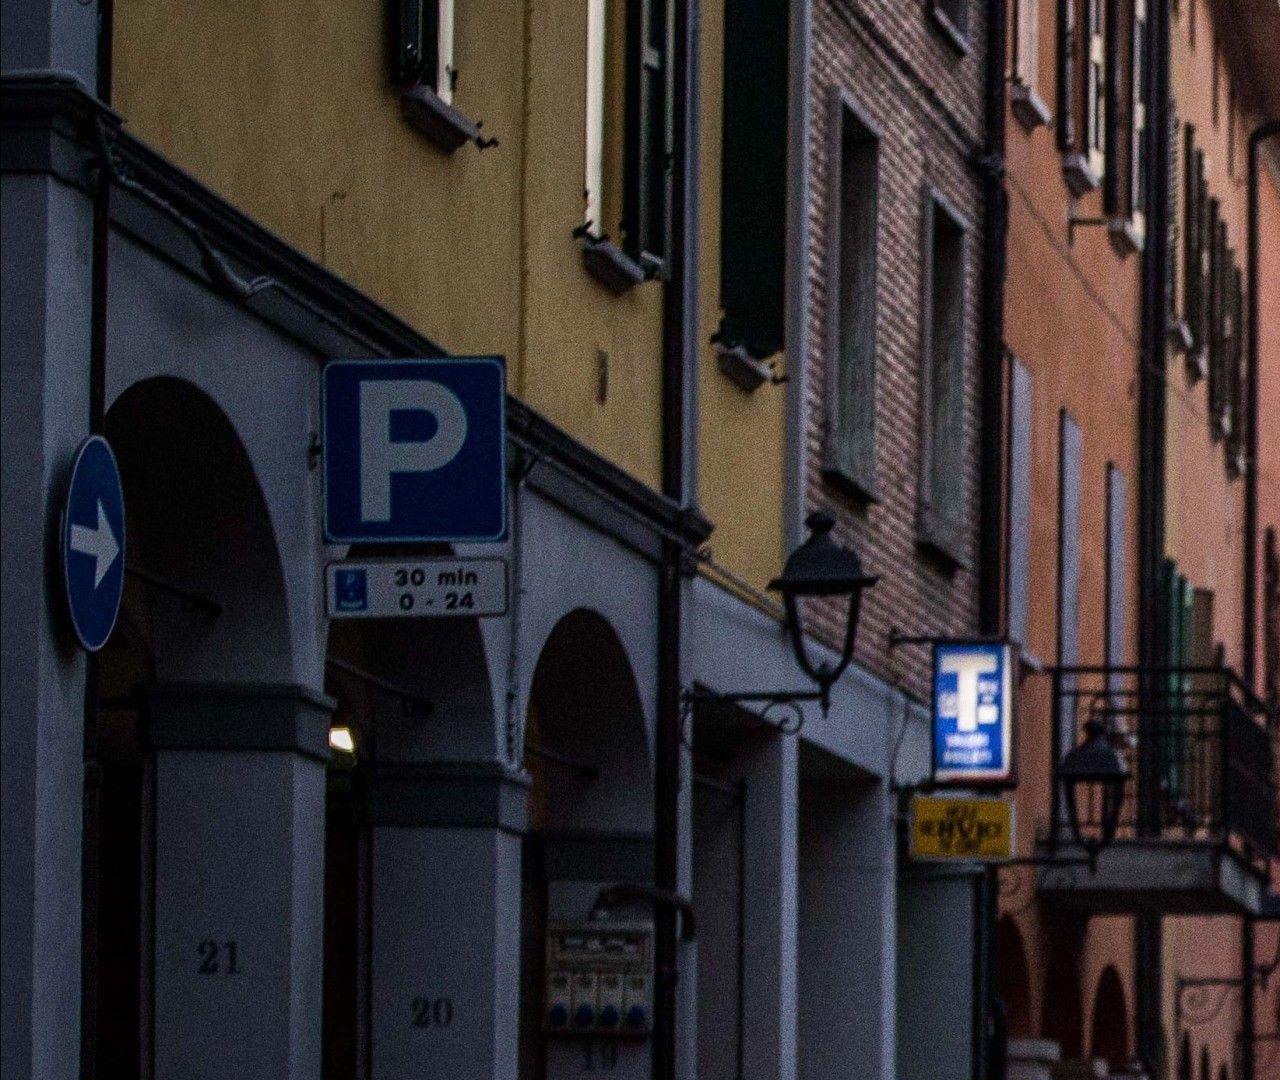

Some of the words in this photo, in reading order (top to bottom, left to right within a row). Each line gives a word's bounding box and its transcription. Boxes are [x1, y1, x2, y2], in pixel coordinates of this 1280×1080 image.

[360, 379, 468, 523] P
[394, 568, 426, 587] 30
[437, 568, 479, 586] min
[398, 593, 415, 611] 0
[444, 592, 475, 610] 24
[939, 653, 998, 732] T
[196, 939, 242, 976] 21
[410, 995, 455, 1030] 20
